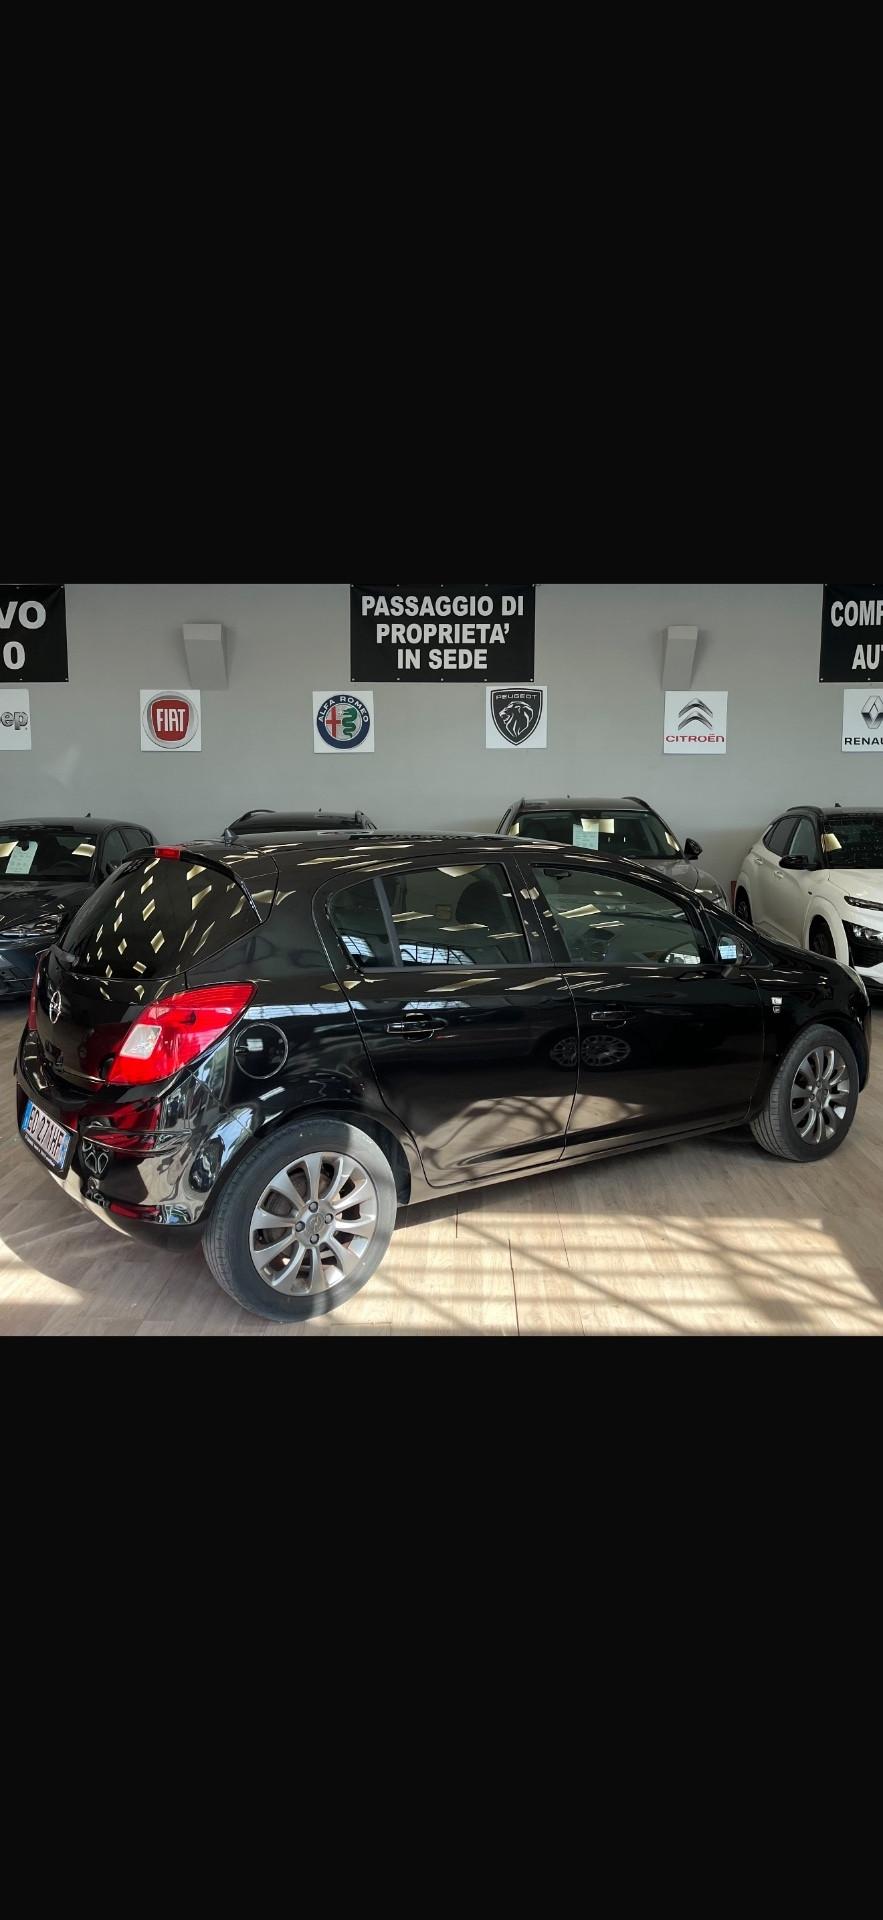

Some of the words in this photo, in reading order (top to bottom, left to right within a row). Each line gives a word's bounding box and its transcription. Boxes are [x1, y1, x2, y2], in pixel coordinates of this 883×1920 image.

[0, 600, 47, 630] VO
[361, 596, 494, 617] PASSAGGIO
[502, 596, 524, 616] DI
[377, 623, 510, 644] PROPRIETA'
[397, 649, 421, 669] IN
[428, 648, 488, 670] SEDE
[851, 644, 883, 670] AU
[156, 708, 186, 732] FIAT
[318, 699, 336, 723] ALFA
[339, 695, 369, 723] ROMEO
